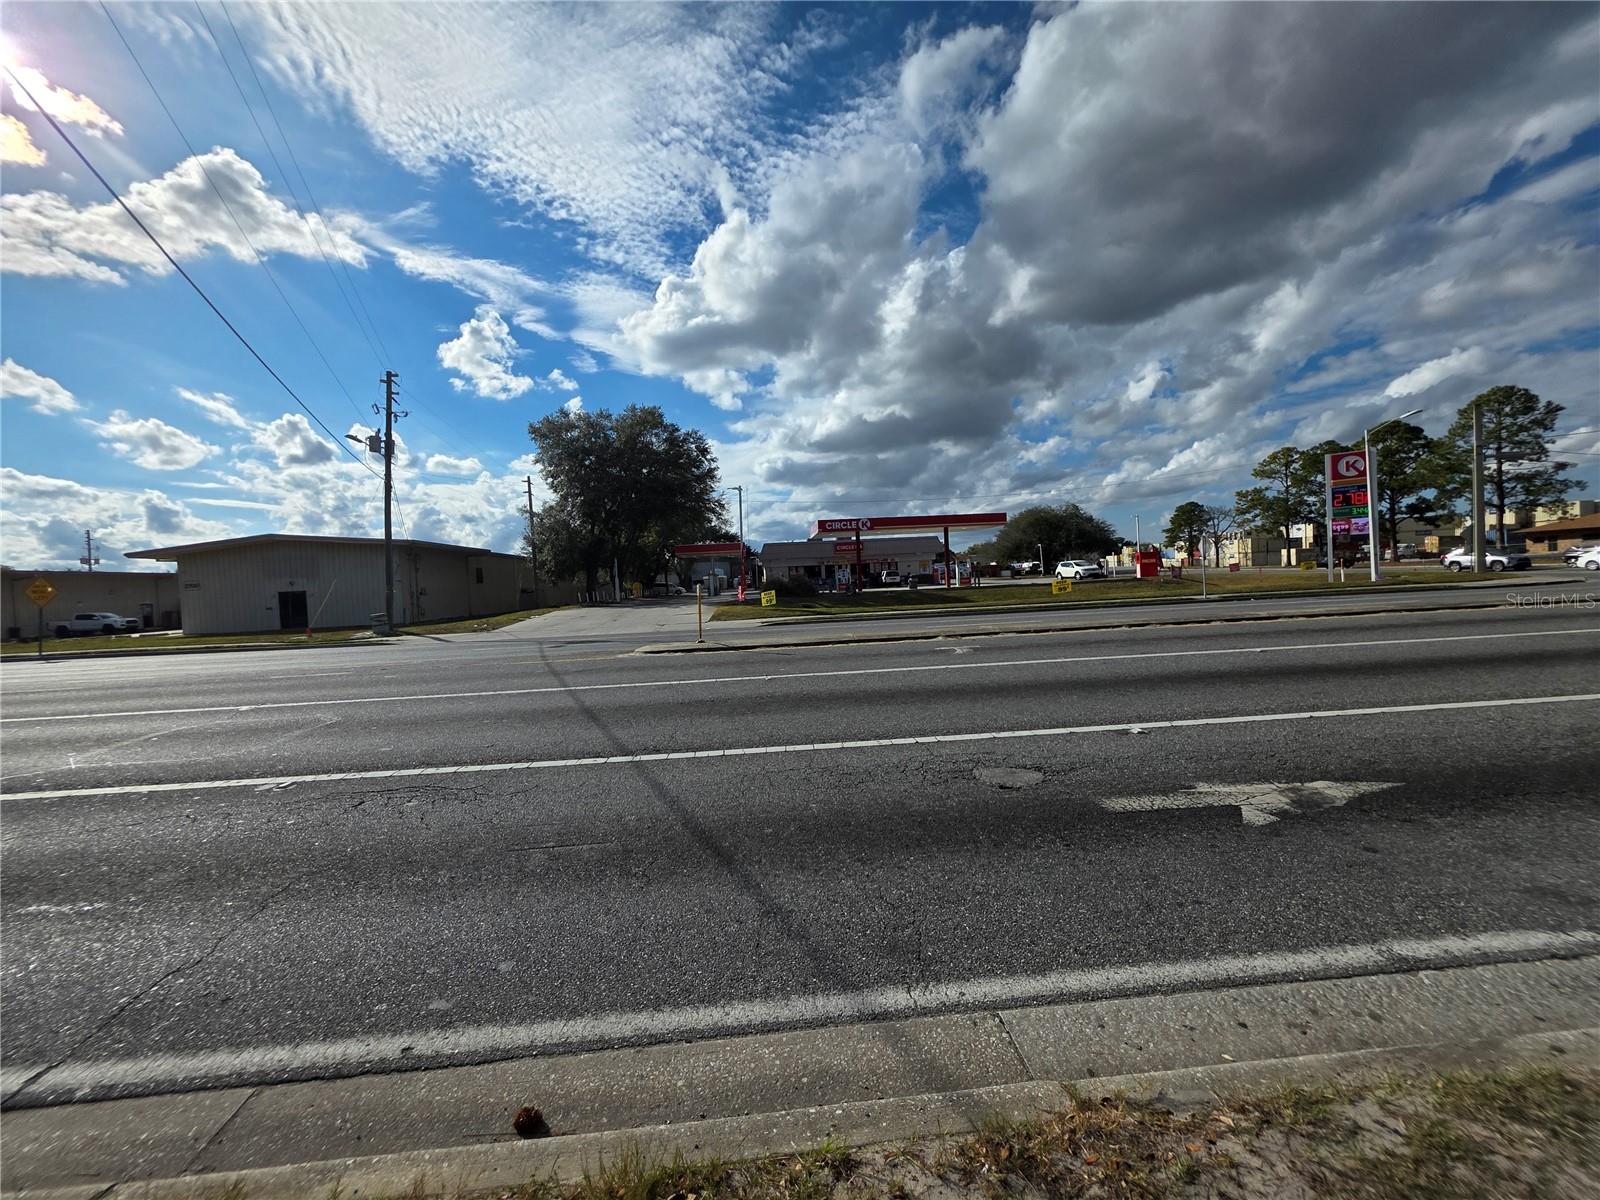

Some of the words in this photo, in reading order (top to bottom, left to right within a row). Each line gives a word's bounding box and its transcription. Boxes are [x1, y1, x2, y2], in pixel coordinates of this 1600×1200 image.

[1341, 457, 1364, 475] K
[825, 521, 857, 529] CIRCLE
[860, 520, 870, 530] K
